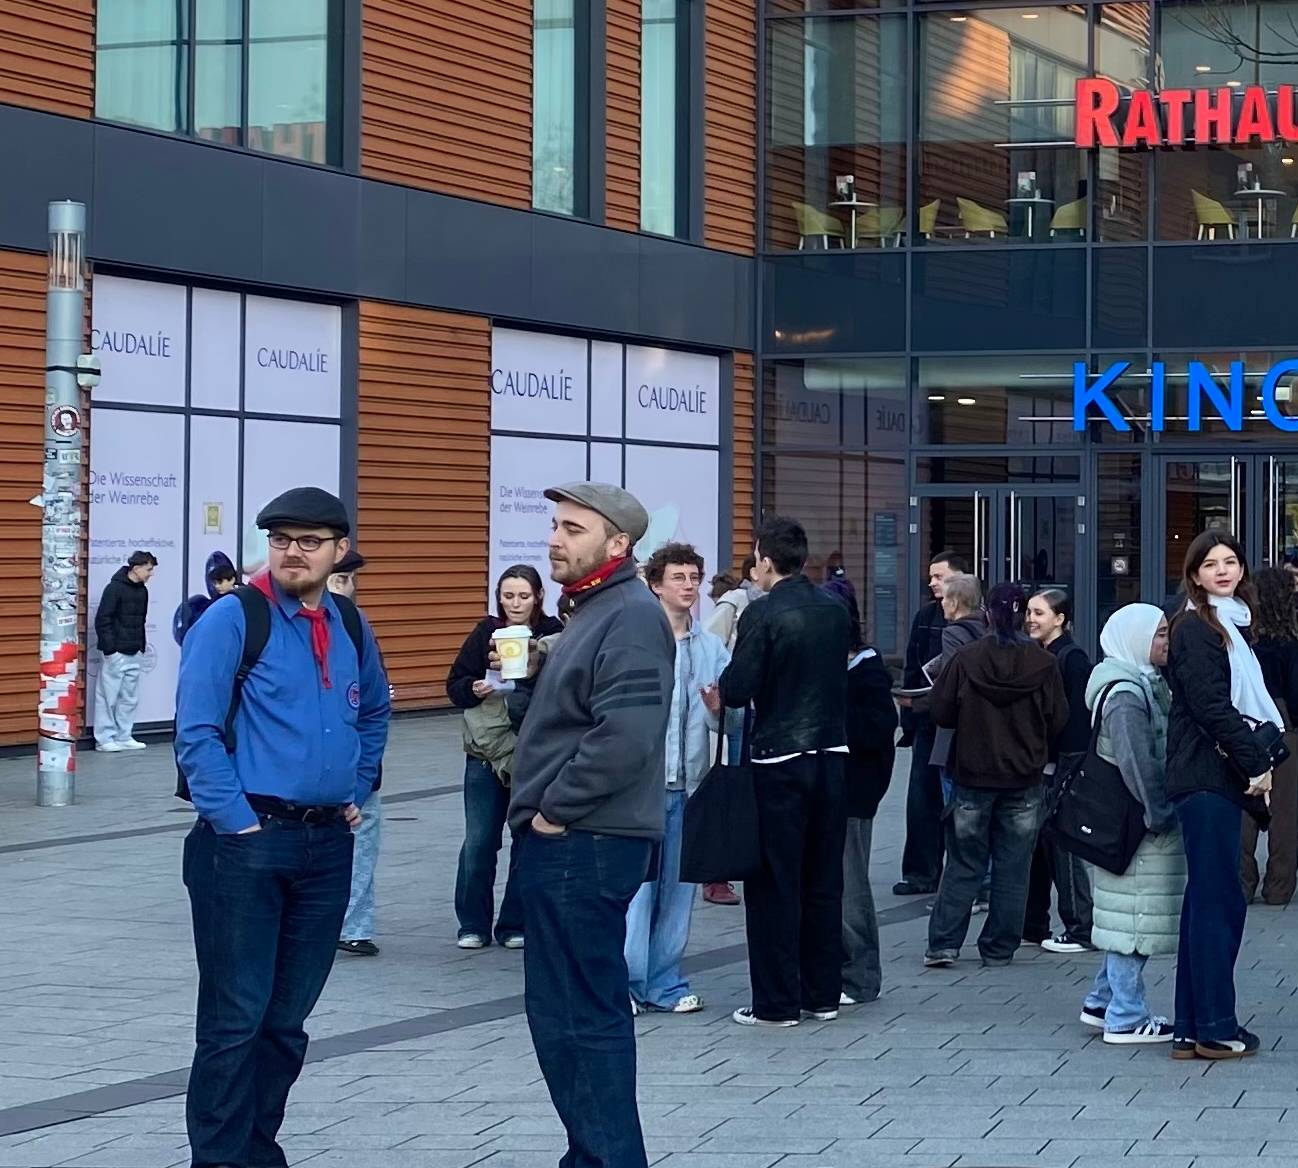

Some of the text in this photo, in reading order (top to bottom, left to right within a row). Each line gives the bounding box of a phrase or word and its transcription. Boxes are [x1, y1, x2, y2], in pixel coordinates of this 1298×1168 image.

[257, 347, 329, 373] CAUDALÍE
[491, 368, 573, 401] CAUDALÍE
[638, 384, 707, 414] CAUDALÍE
[109, 472, 177, 488] Wissenschaft
[108, 491, 160, 505] Weinrebe
[514, 487, 545, 499] Wissens
